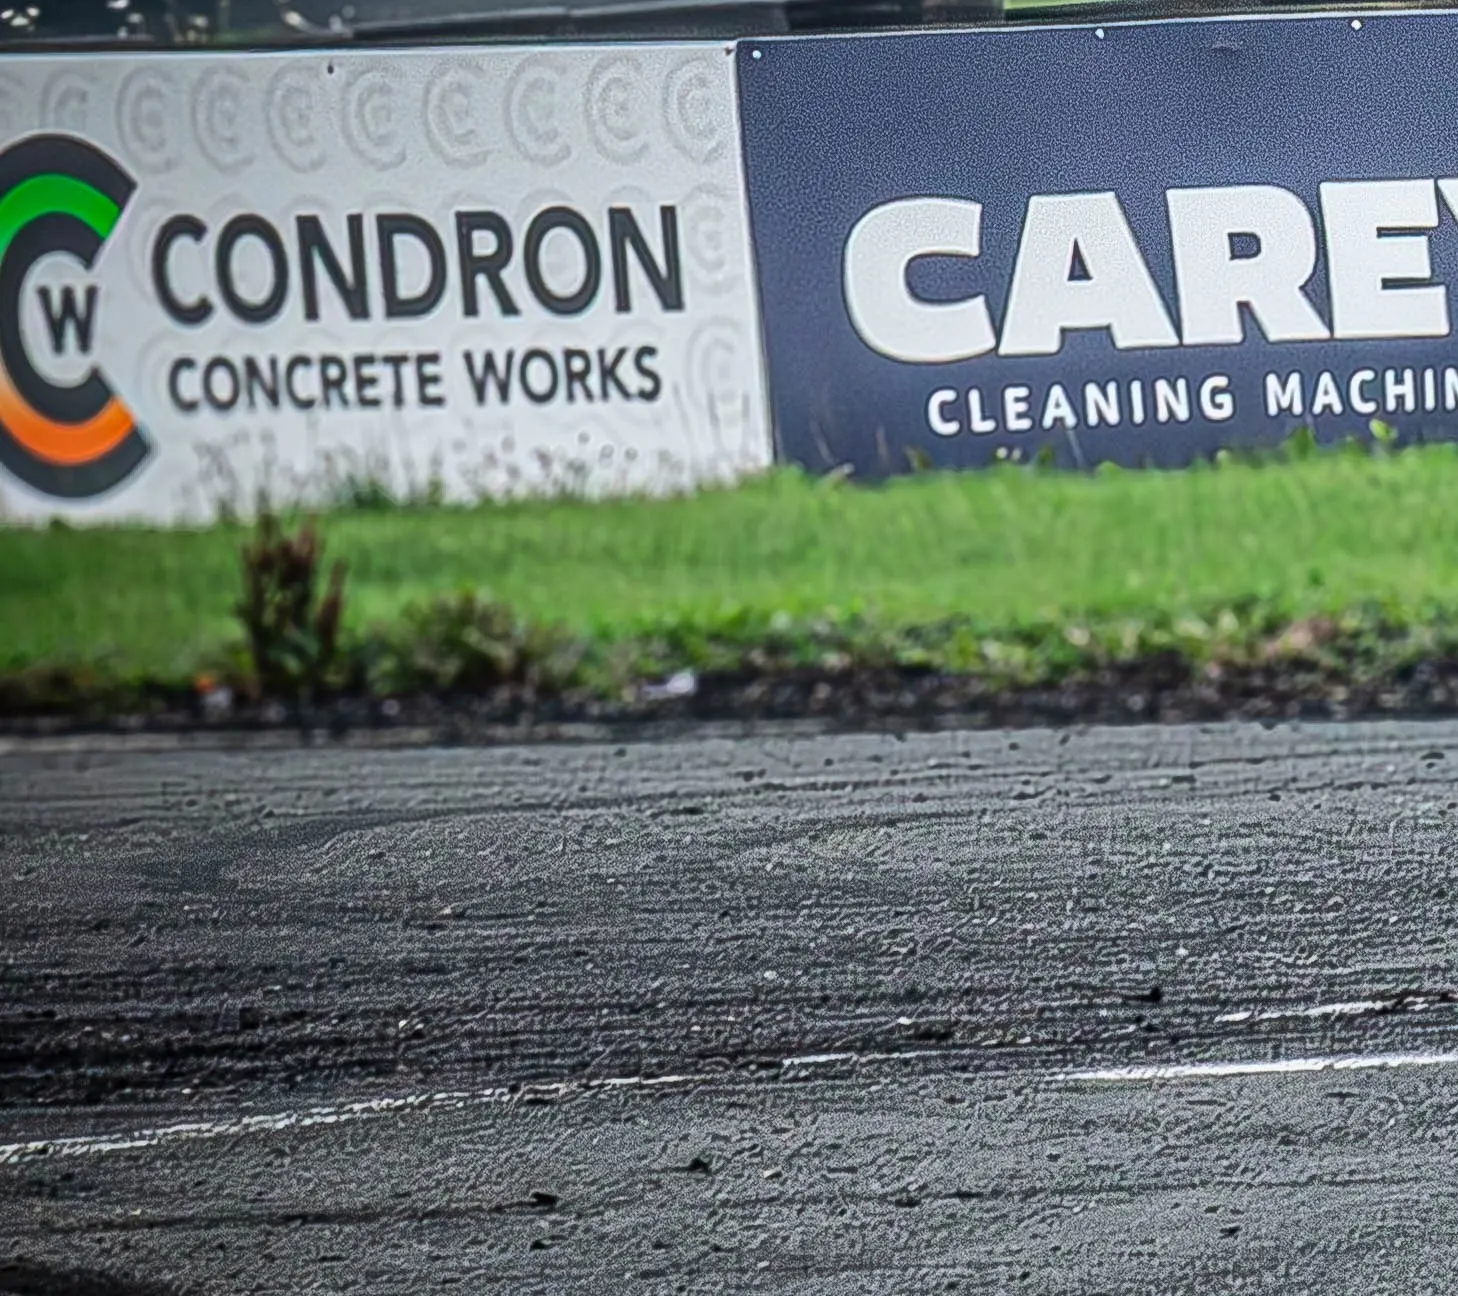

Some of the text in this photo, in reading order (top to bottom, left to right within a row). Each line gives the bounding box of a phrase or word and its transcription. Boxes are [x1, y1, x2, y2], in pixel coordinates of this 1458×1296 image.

[152, 204, 685, 325] CONDRON
[169, 344, 663, 412] CONCRETE WORKS
[926, 373, 1236, 437] CLEANING
